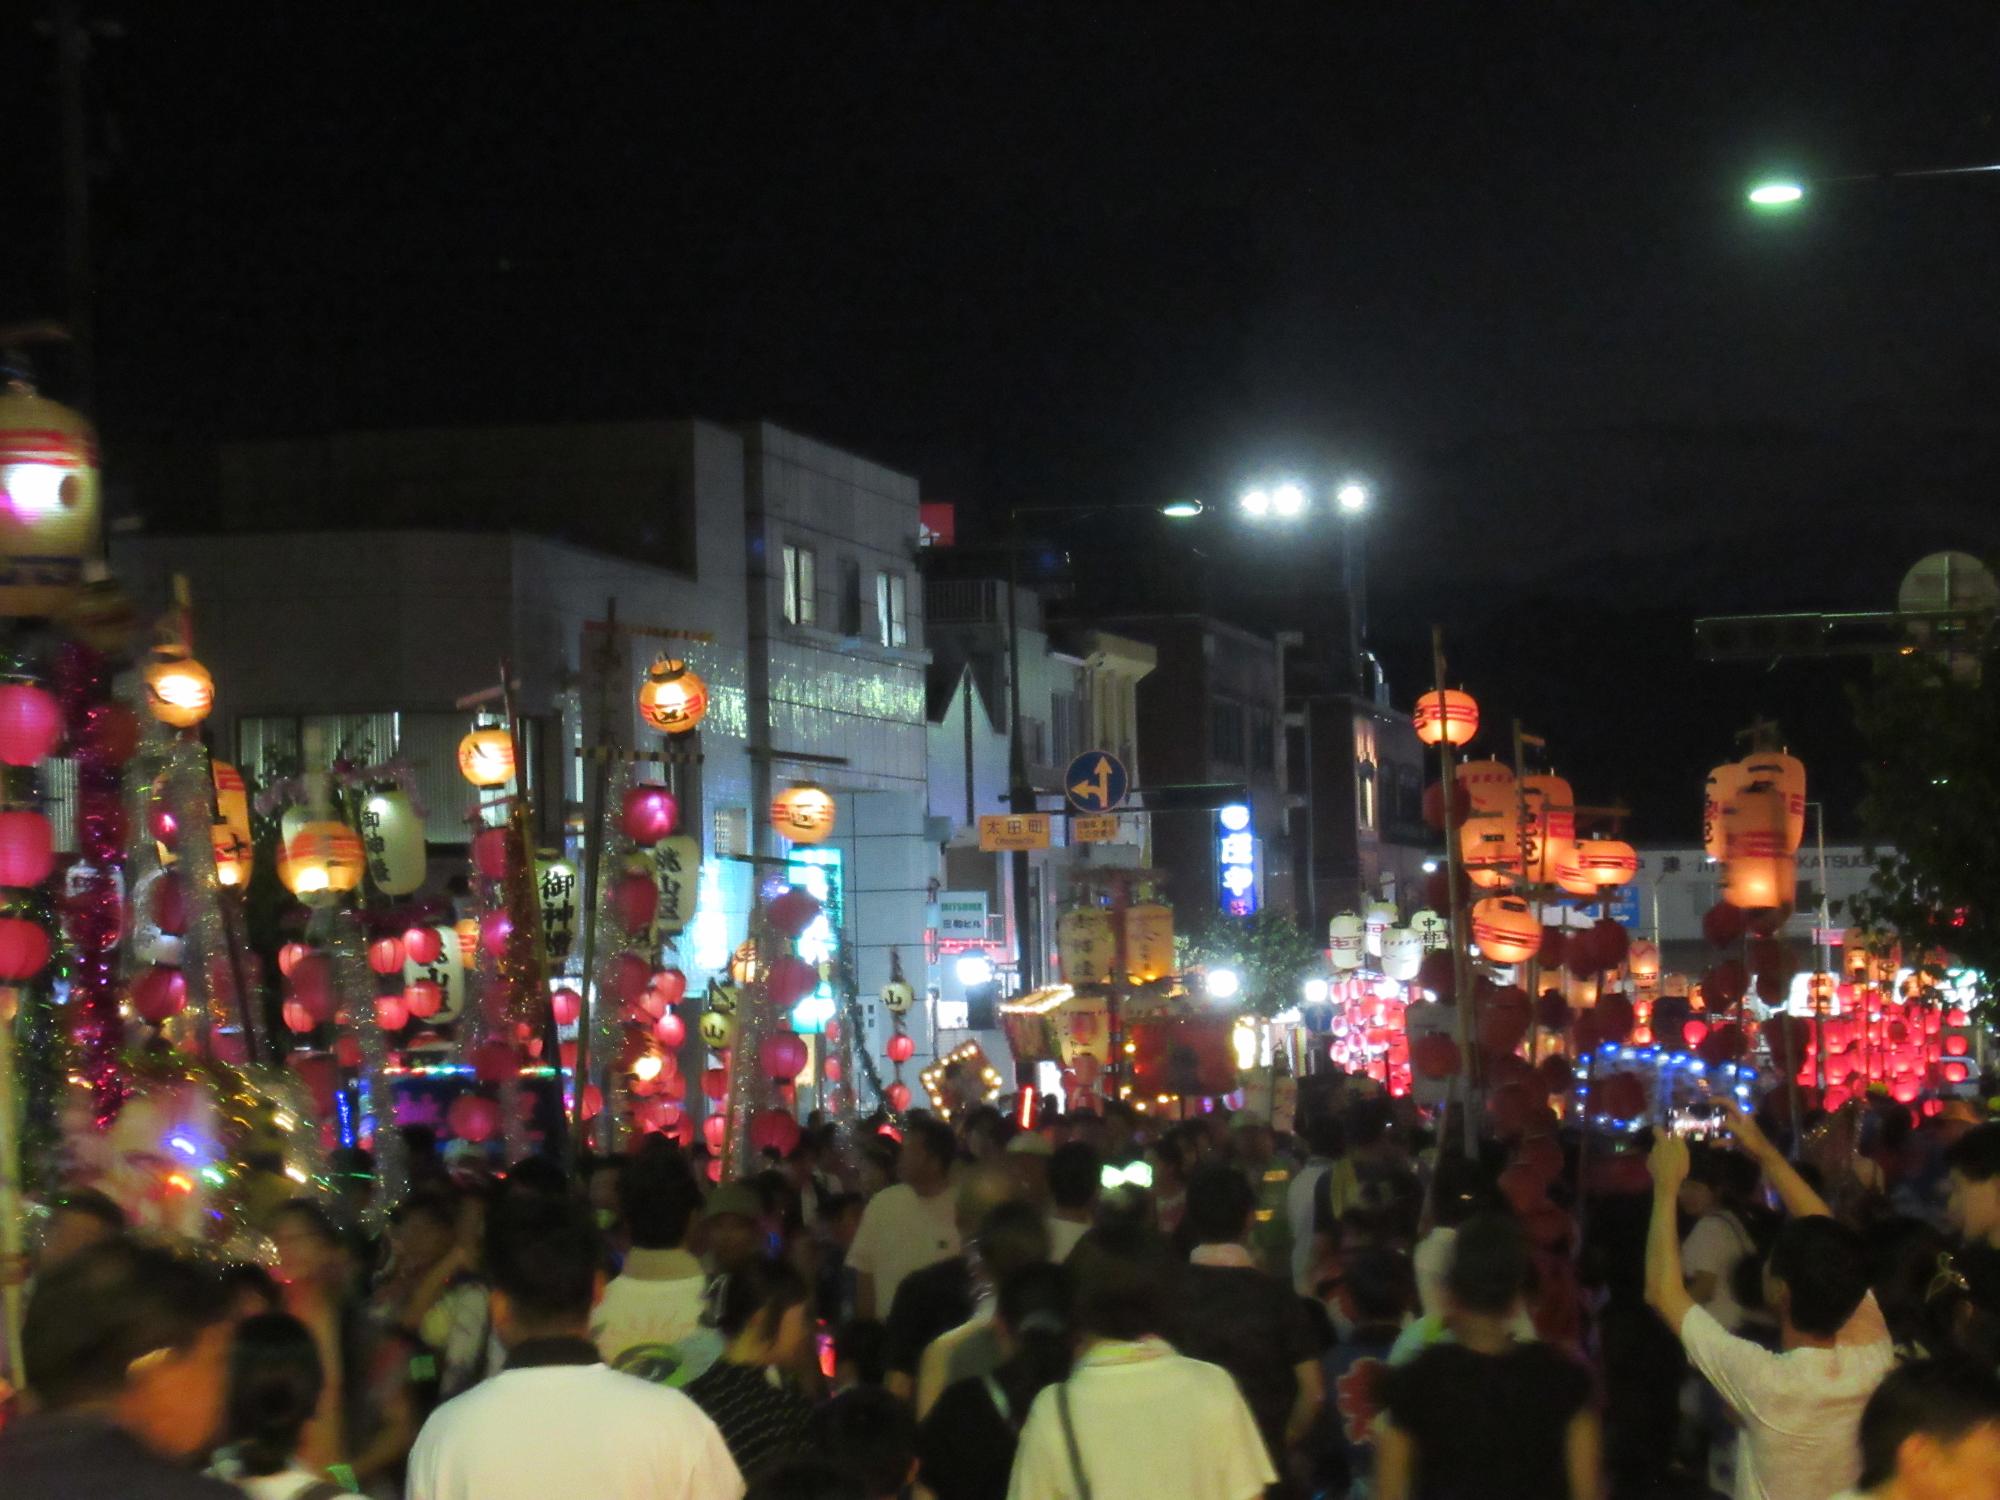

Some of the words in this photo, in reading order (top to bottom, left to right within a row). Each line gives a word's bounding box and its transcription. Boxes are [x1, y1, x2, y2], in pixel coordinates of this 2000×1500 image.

[987, 820, 1041, 834] 太田町
[704, 1024, 725, 1040] 山
